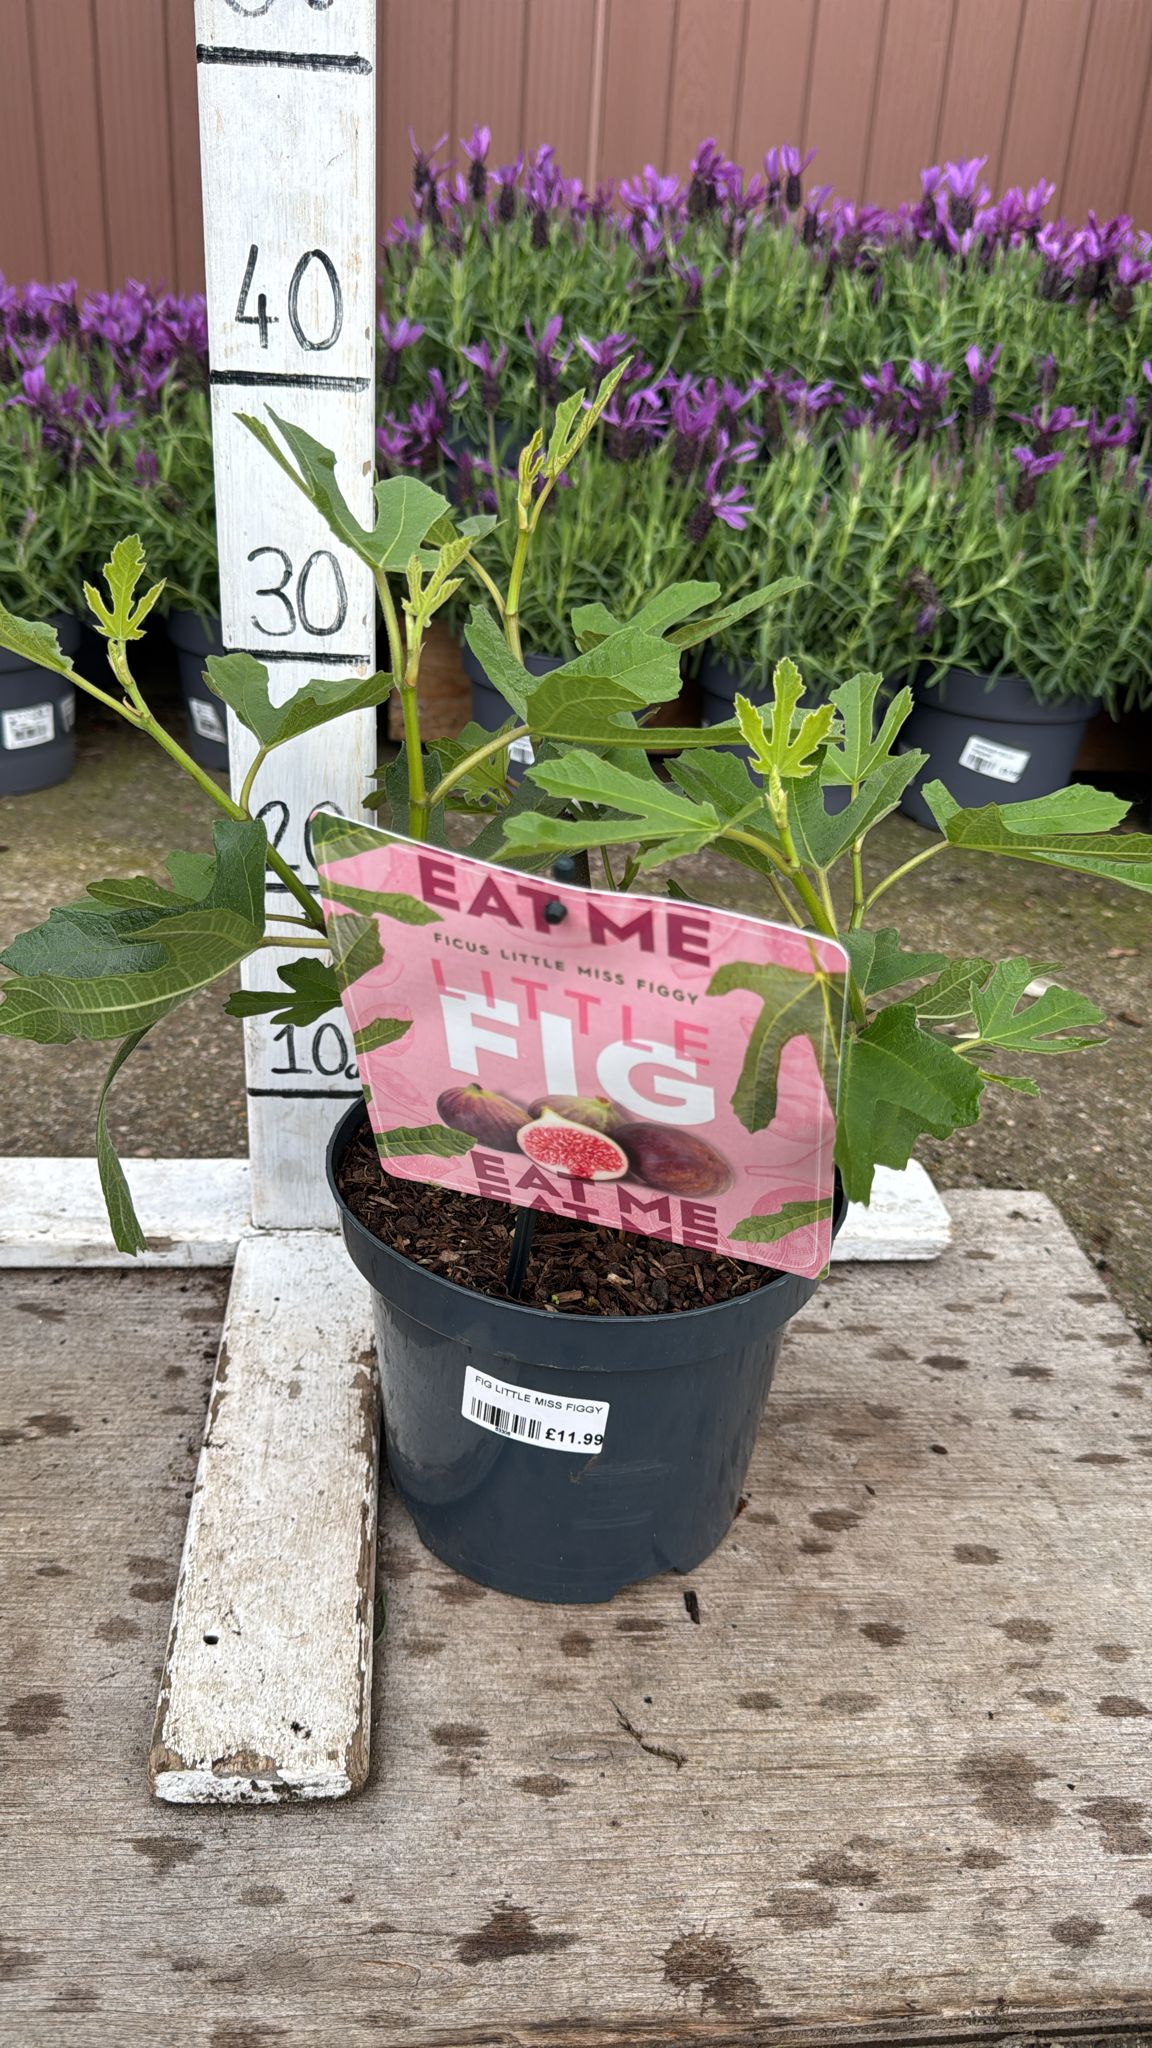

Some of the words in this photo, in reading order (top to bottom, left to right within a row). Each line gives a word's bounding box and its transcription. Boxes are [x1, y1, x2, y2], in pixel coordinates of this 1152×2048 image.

[235, 244, 343, 351] 40
[247, 546, 348, 636] 30
[418, 855, 559, 935] EAT
[587, 902, 710, 967] ME
[431, 958, 710, 1066] LITTLE
[434, 933, 489, 955] FICUS
[500, 949, 565, 972] LITTLE
[578, 966, 624, 986] MISS
[637, 979, 698, 1004] FIGGY
[440, 986, 715, 1125] FIG
[471, 1150, 595, 1203] EAT
[617, 1184, 718, 1235] ME
[475, 1375, 493, 1388] FIG
[495, 1385, 531, 1403] LITTLE
[534, 1397, 563, 1409] MISS
[566, 1403, 603, 1414] FIGGY
[545, 1428, 604, 1445] £11.99
